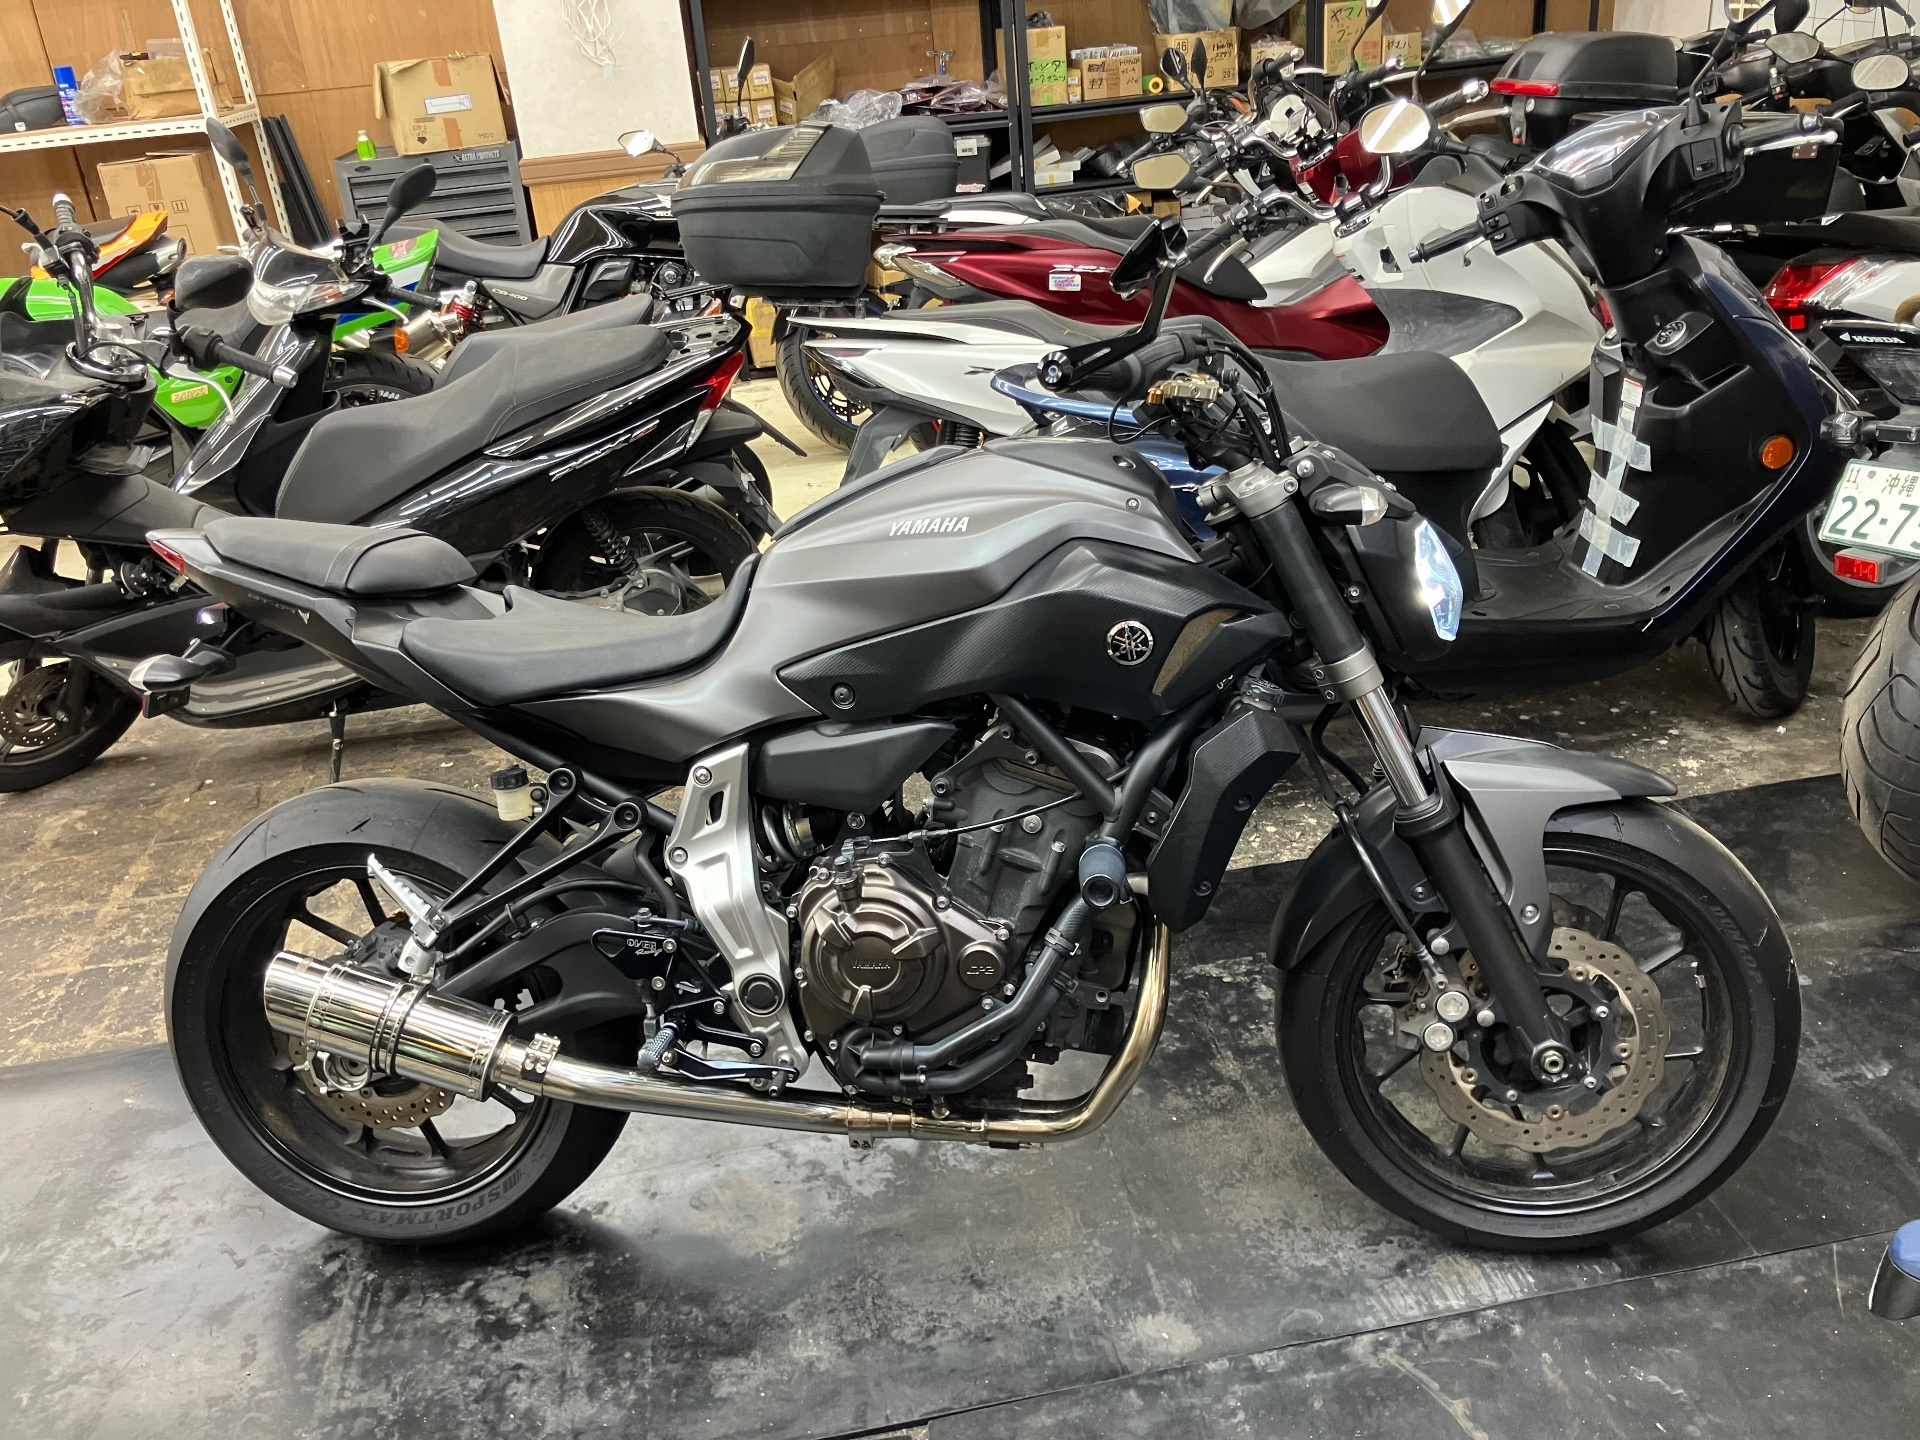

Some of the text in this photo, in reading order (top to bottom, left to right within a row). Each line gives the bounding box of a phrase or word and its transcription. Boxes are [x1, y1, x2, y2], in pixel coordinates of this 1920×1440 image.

[1851, 335, 1906, 344] HONDA
[1881, 473, 1919, 498] 沖縄
[889, 516, 970, 537] YAMAHA
[626, 938, 657, 950] OVER
